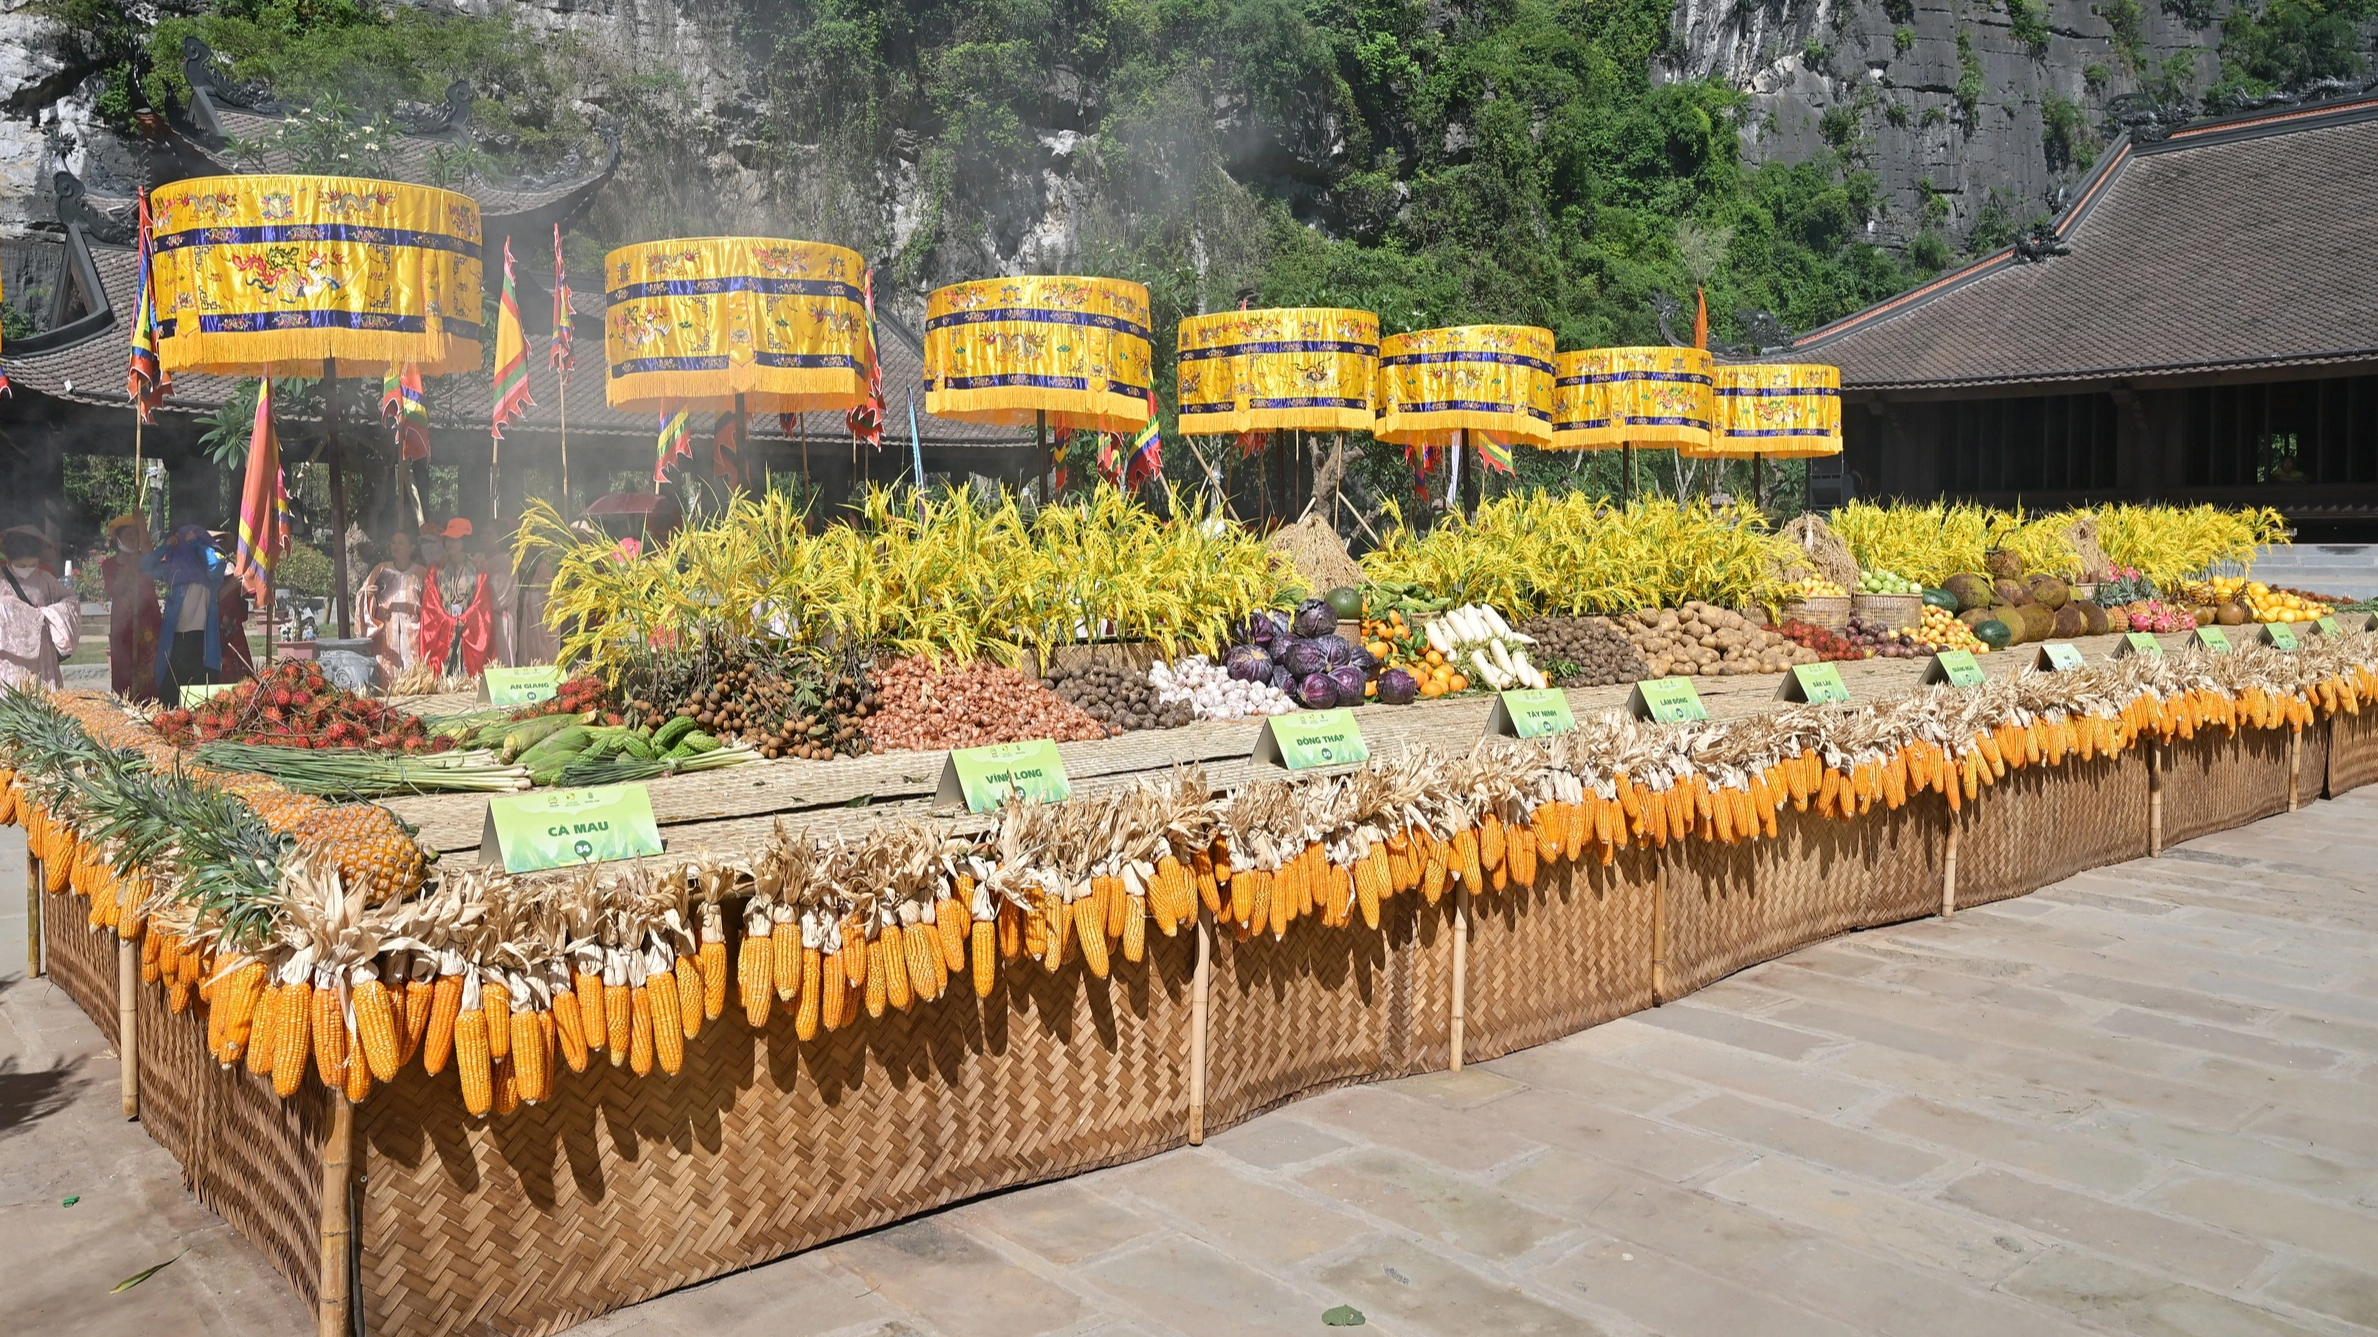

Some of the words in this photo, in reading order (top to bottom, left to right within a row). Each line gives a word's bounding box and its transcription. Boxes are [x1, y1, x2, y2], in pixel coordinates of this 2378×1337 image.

[1014, 768, 1043, 780] LONG
[574, 821, 609, 834] MAU
[576, 845, 591, 854] 34
